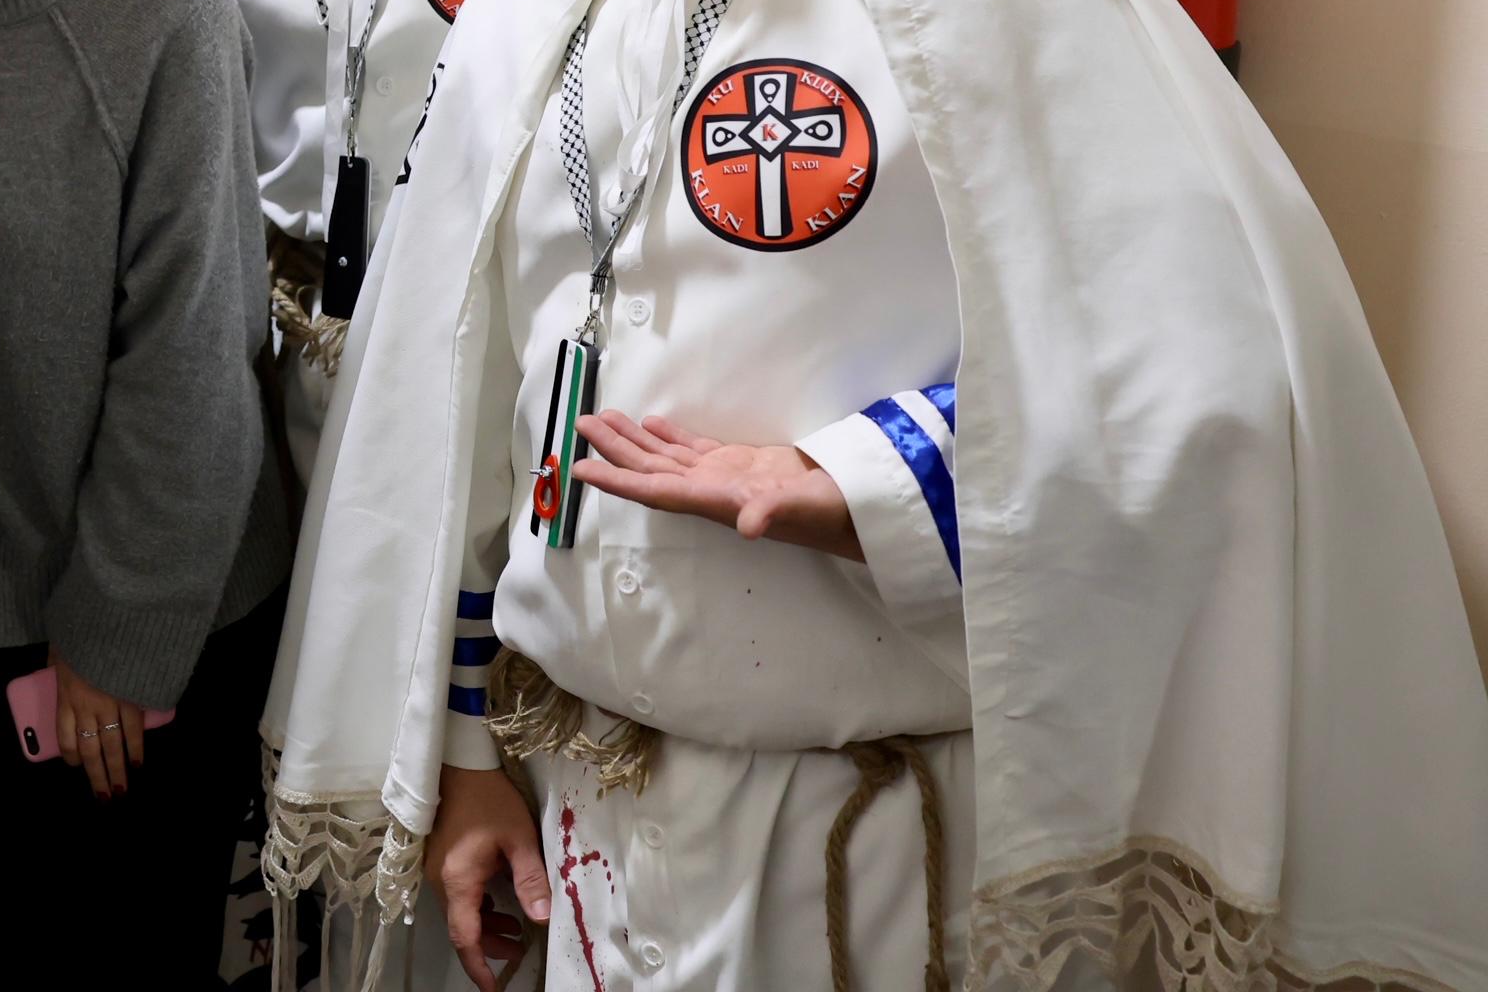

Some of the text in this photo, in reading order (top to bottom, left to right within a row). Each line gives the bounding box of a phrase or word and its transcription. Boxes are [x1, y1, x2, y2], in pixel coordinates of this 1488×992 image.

[707, 71, 845, 106] KU KLUX
[760, 123, 779, 141] K
[723, 159, 819, 175] KADI KADI
[691, 163, 867, 232] KLAN KLAN
